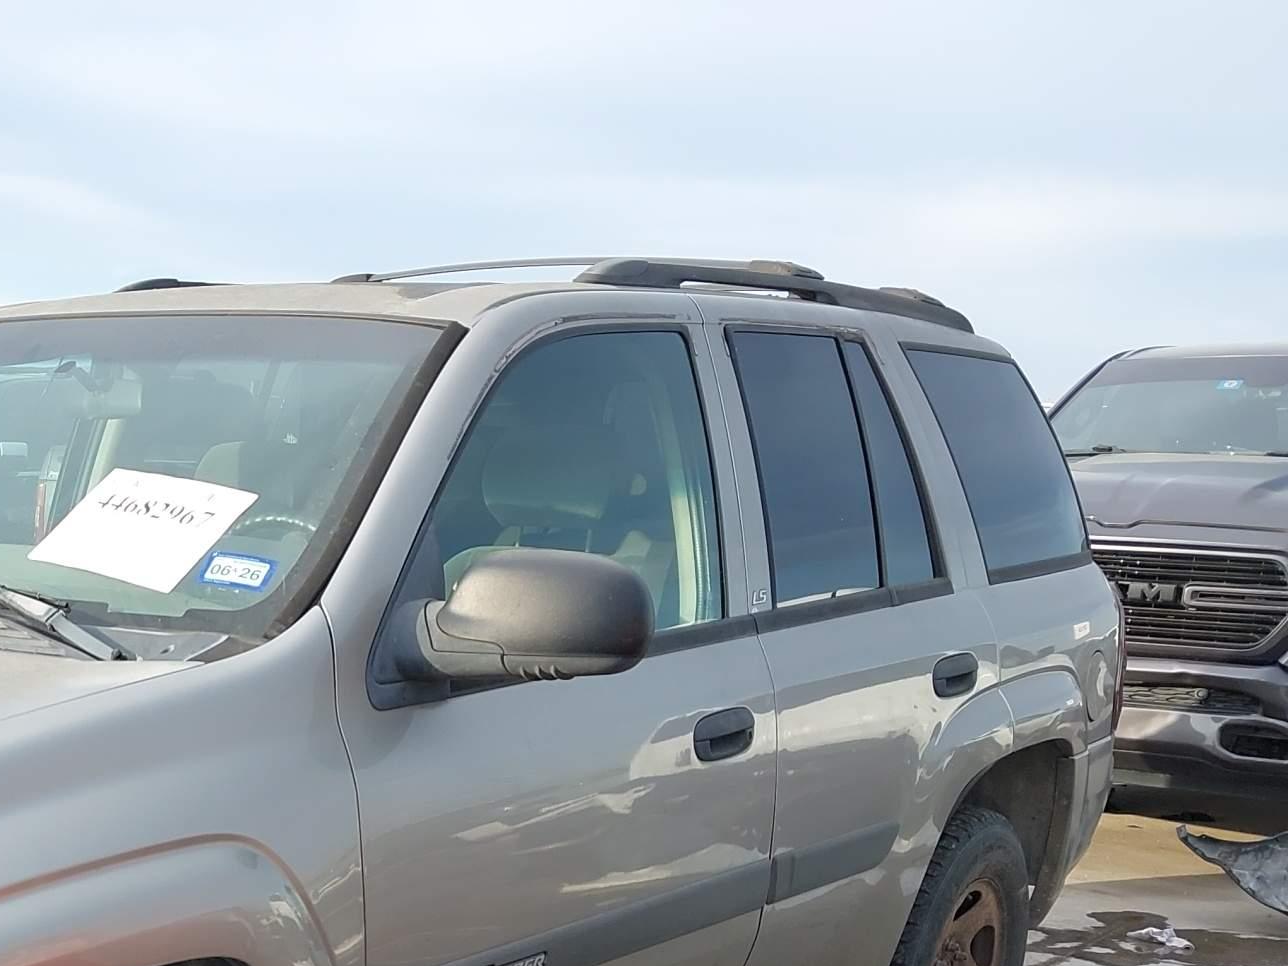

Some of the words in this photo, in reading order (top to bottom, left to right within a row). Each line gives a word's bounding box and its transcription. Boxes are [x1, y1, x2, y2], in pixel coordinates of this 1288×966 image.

[98, 494, 216, 526] 44682967
[210, 564, 232, 576] 06
[238, 568, 262, 581] 26
[752, 590, 767, 605] LS
